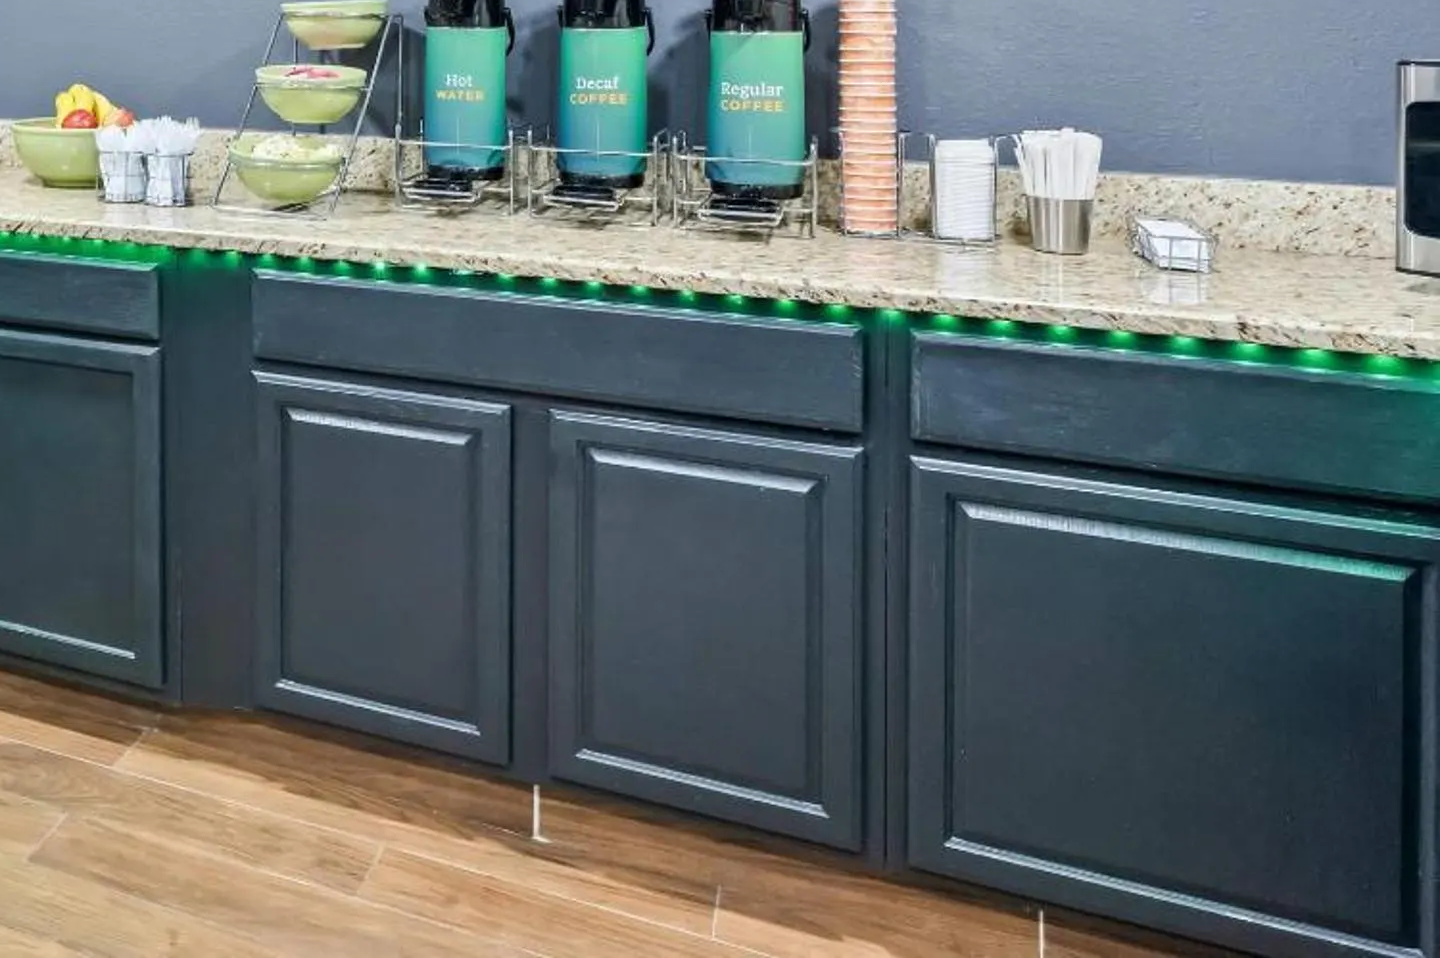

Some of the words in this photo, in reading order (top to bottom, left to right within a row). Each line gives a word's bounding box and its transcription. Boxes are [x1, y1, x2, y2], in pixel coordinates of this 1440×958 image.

[444, 73, 473, 88] Hot
[575, 75, 620, 90] Decaf
[435, 90, 486, 102] WATER
[720, 81, 784, 100] Regular
[570, 92, 628, 105] COFFEE
[720, 99, 784, 112] COFFEE
